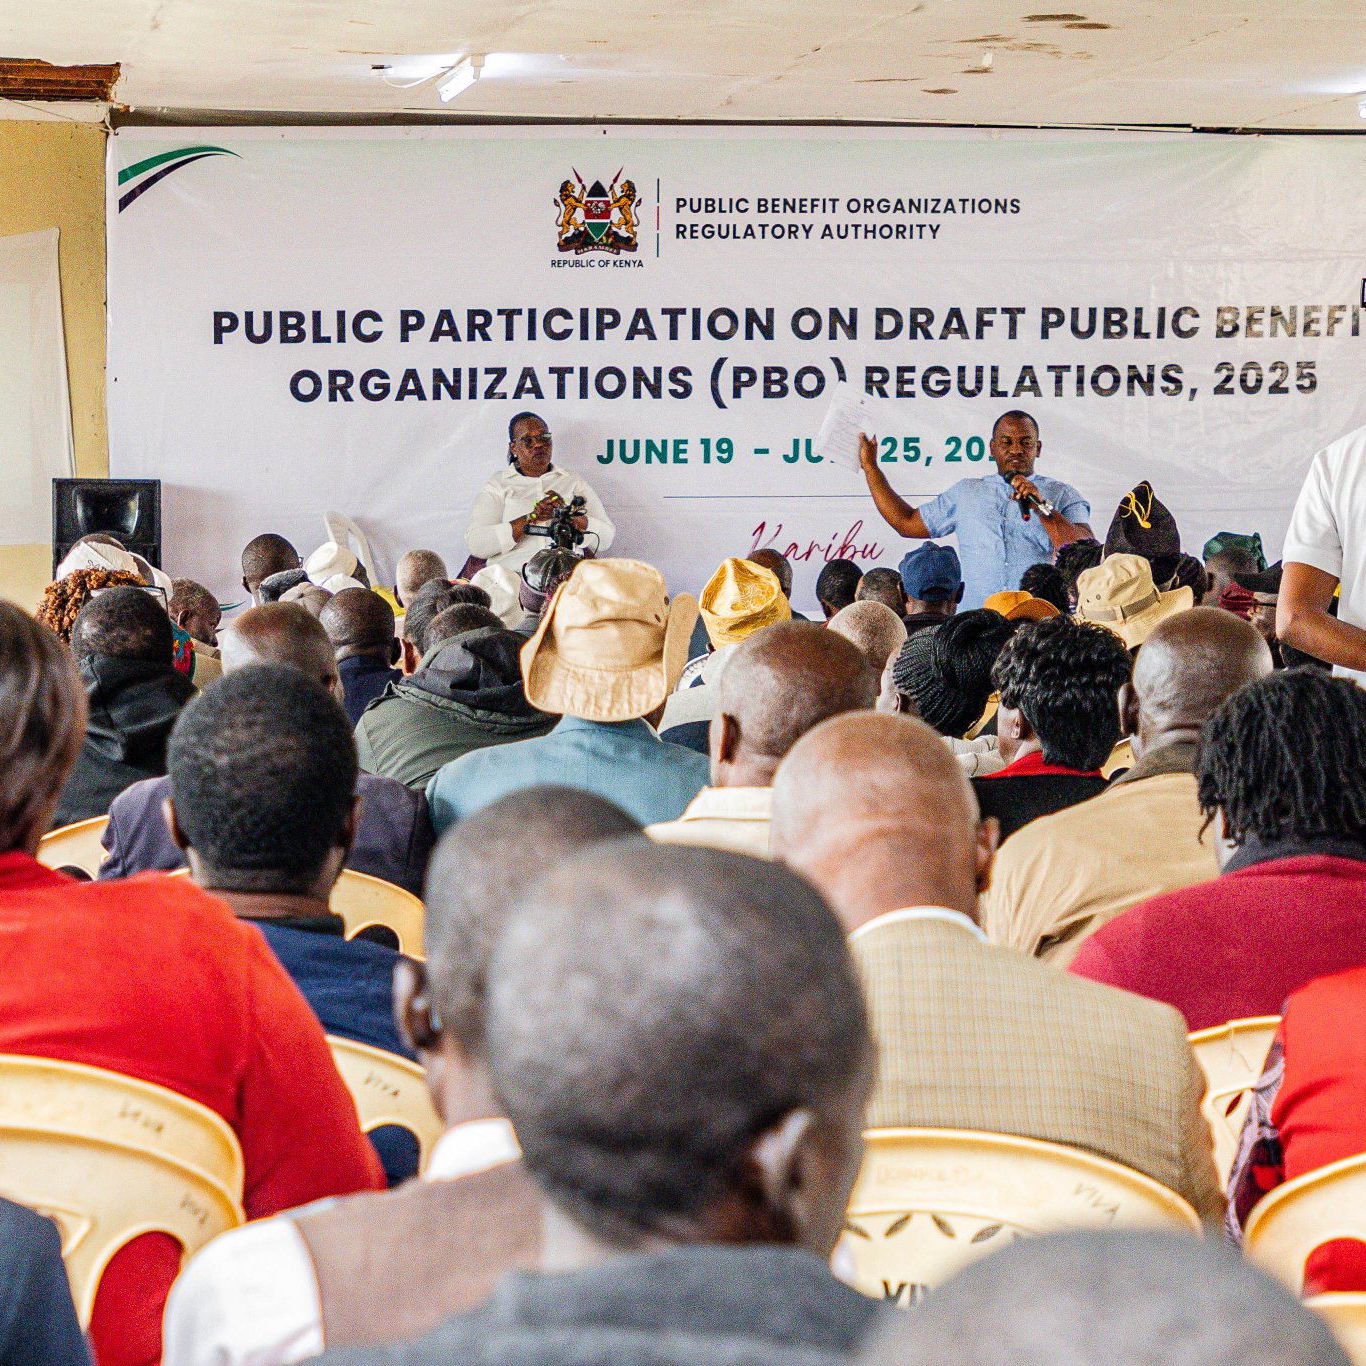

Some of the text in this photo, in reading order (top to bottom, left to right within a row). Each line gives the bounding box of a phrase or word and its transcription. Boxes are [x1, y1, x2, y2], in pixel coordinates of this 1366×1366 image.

[676, 198, 1021, 214] PUBLIC BENEFIT ORGANIZATIONS
[676, 224, 941, 240] REGULATORY AUTHORITY
[551, 259, 644, 268] REPUBLIC OF KENYA
[214, 310, 383, 344] PUBLIC
[400, 307, 774, 342] PARTICIPATION
[791, 307, 857, 340] ON
[875, 307, 1024, 340] DRAFT
[1041, 306, 1199, 340] PUBLIC
[290, 366, 692, 402] ORGANIZATIONS
[865, 362, 1197, 402] REGULATIONS,
[1214, 360, 1318, 396] 2025
[596, 438, 688, 465] JUNE
[699, 438, 734, 465] 19
[880, 436, 933, 467] 25,
[944, 436, 995, 463] 20
